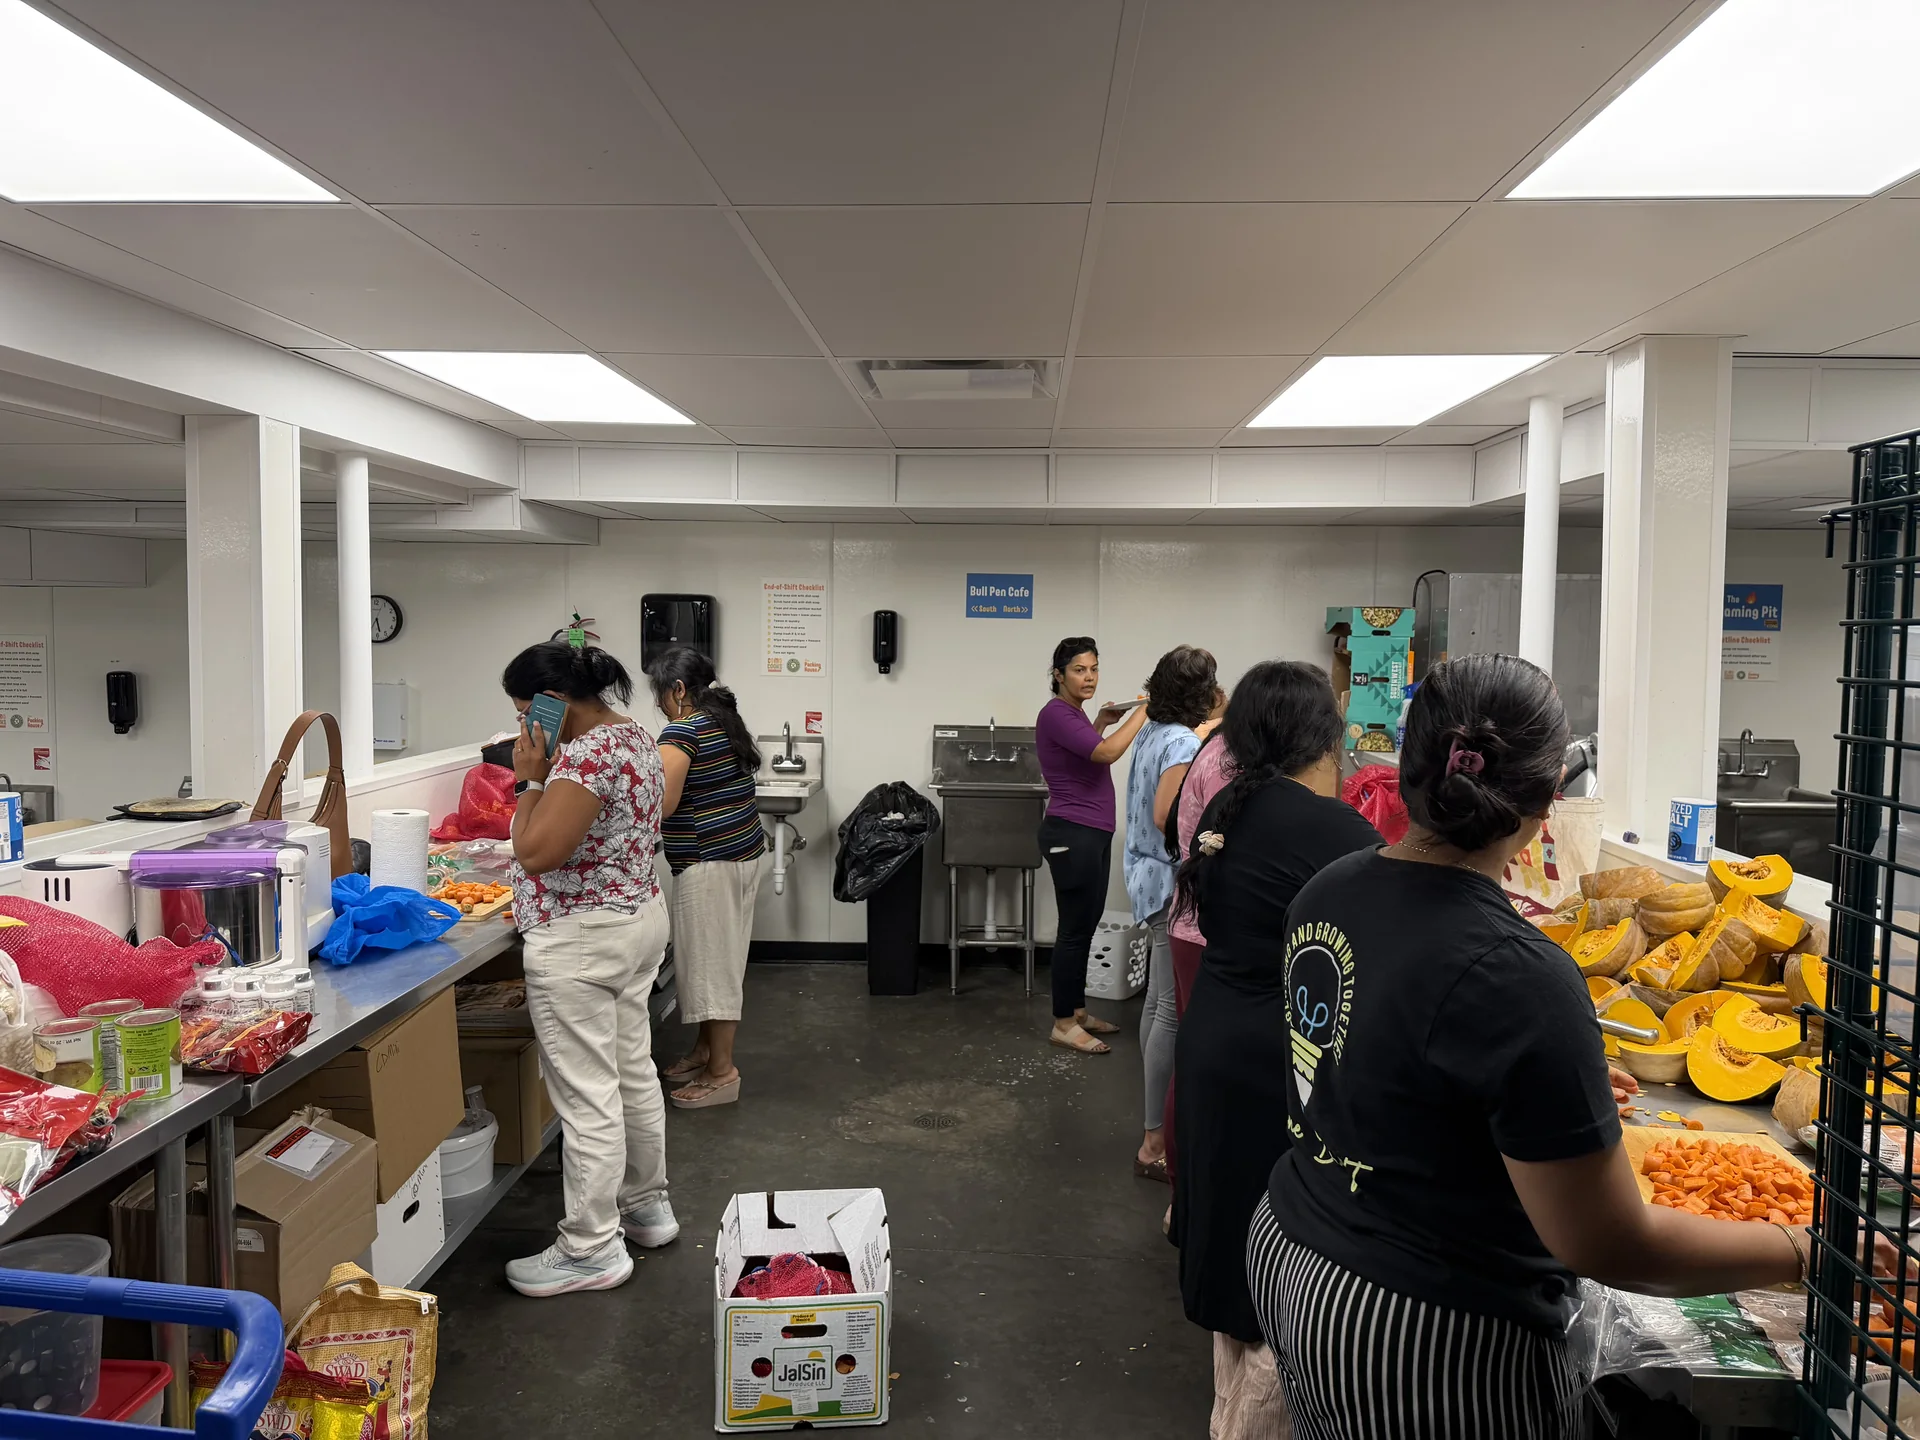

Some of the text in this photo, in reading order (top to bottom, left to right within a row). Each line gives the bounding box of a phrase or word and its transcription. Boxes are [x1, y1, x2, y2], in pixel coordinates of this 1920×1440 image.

[970, 585, 1030, 598] Bull Pen Cafe
[1726, 594, 1740, 604] The
[1761, 605, 1778, 618] Pit
[1390, 660, 1398, 699] SOUTHWEST
[1292, 922, 1313, 950] AND
[1315, 921, 1355, 976] GROWING
[325, 1362, 365, 1378] SWAD
[778, 1362, 826, 1382] JalSin
